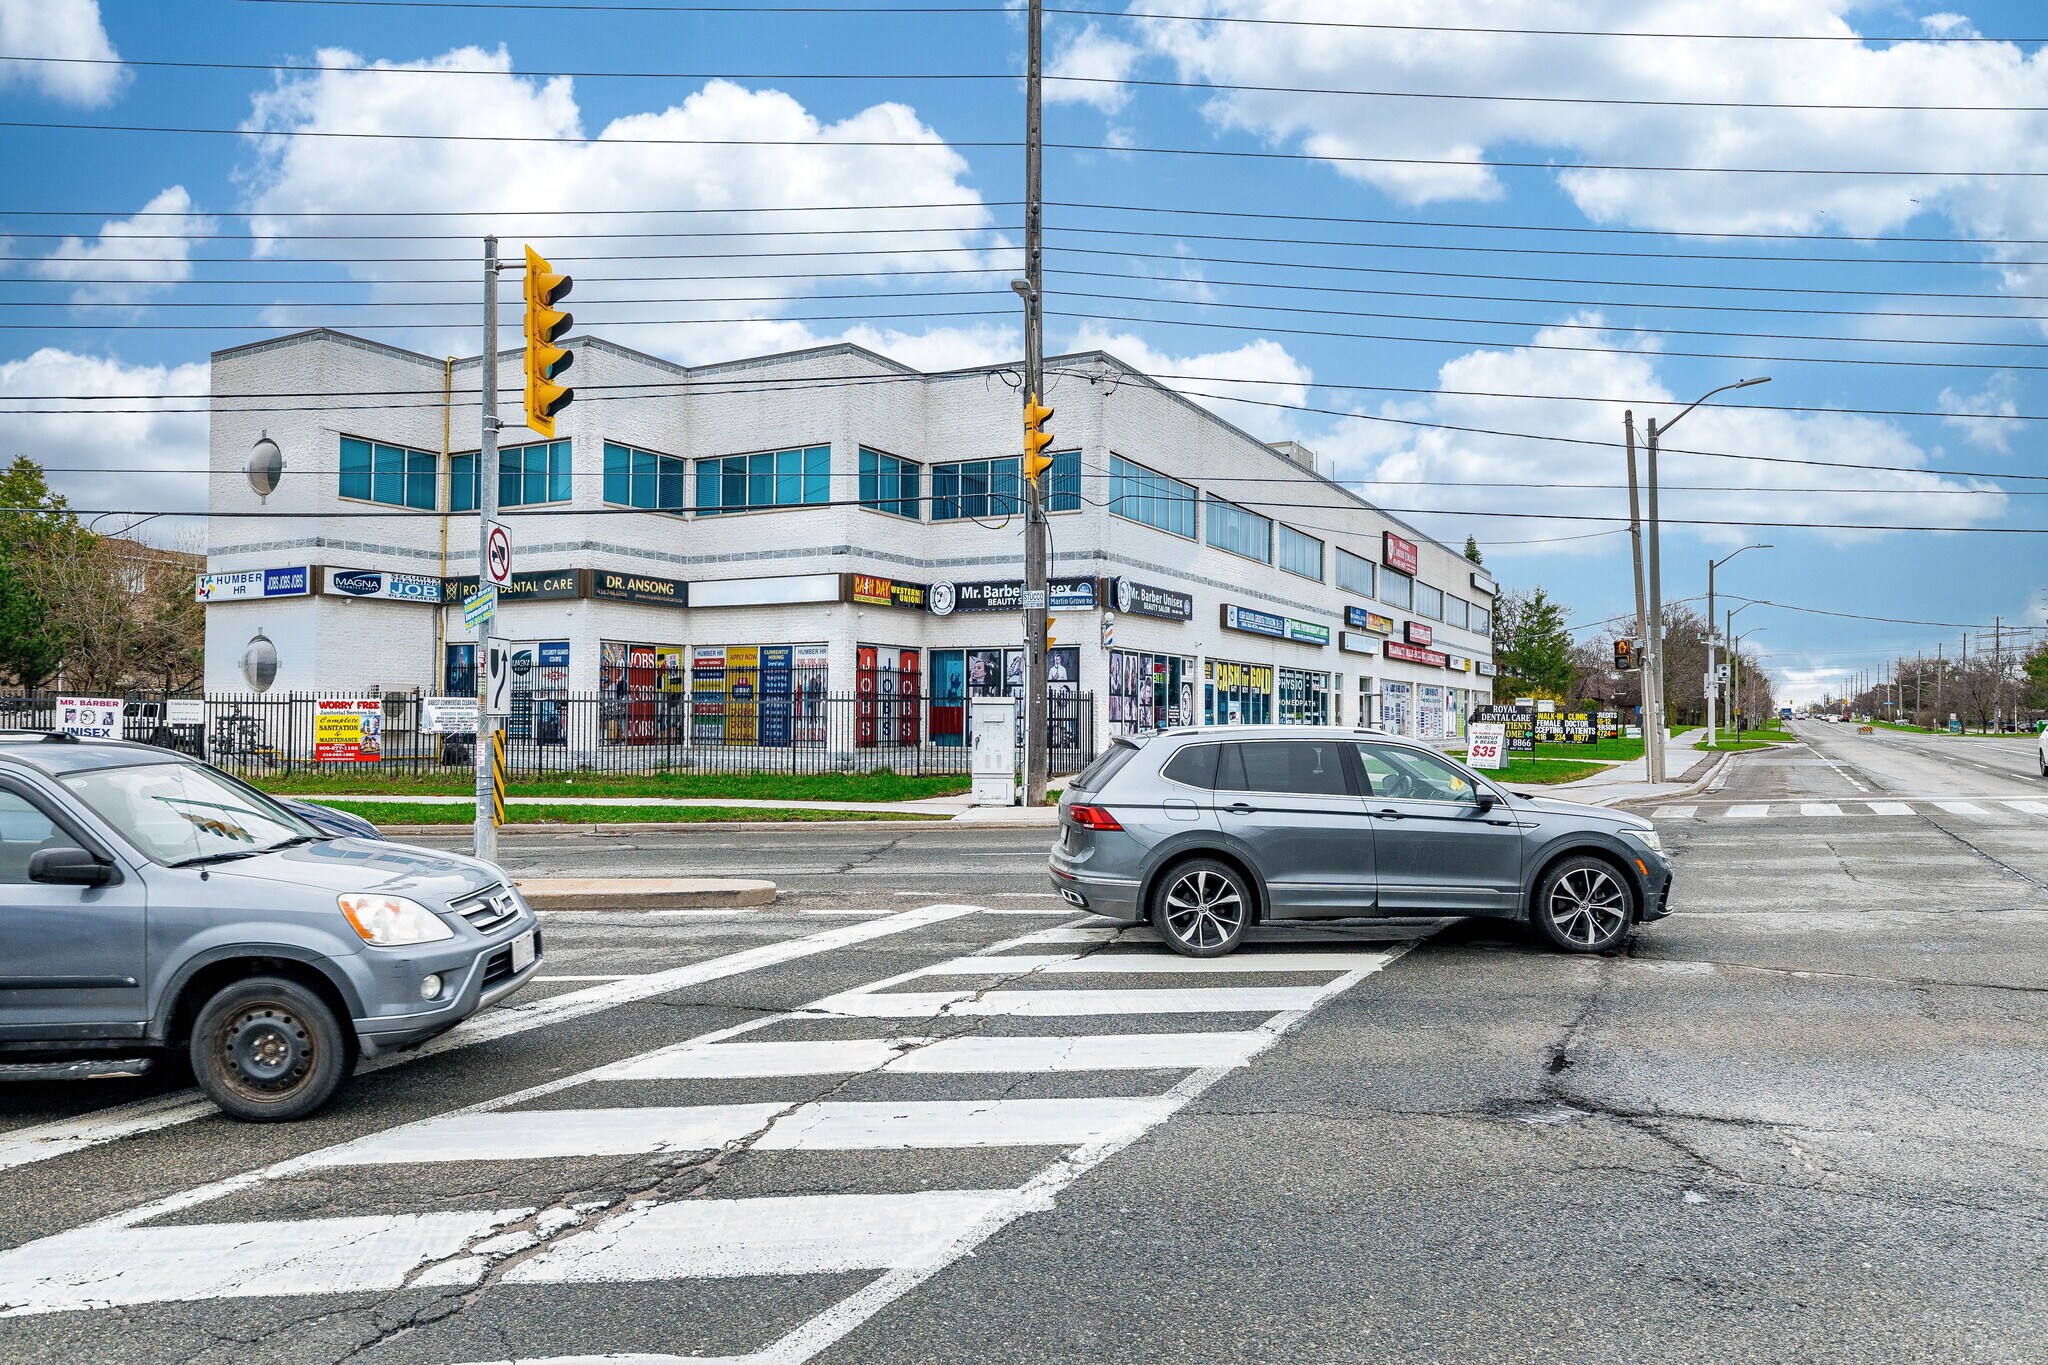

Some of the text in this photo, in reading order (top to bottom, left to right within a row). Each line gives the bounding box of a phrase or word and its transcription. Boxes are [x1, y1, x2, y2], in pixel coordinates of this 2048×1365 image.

[216, 573, 262, 585] HUMBER
[266, 574, 303, 591] JOBS JOBS JOBS
[335, 577, 379, 589] MAGNA
[391, 574, 440, 583] SECURITY
[391, 578, 440, 587] TRAINING
[391, 582, 438, 597] JOB
[463, 584, 480, 596] RO
[543, 578, 573, 591] CARE
[606, 575, 674, 595] DR. ANSONG
[875, 579, 891, 598] DAY
[233, 585, 246, 595] HR
[891, 585, 920, 597] WESTERN
[961, 583, 1072, 599] Mr. Barbe sex
[388, 594, 440, 602] PLACEMENT
[899, 594, 920, 604] UNION
[1024, 592, 1043, 601] STUCCO
[1050, 597, 1069, 605] Martin
[1069, 597, 1086, 605] Grove
[1130, 586, 1183, 608] Mr. Barber Unisex
[987, 598, 1016, 606] BEAUTY
[465, 602, 492, 622] Inventory
[1143, 602, 1170, 613] BEAUTY SALON
[628, 652, 654, 669] JOBS
[1217, 663, 1240, 692] CASH
[1252, 667, 1271, 695] GOLD
[318, 700, 380, 709] WORRY FREE
[1279, 699, 1318, 707] OMEOPATH
[1492, 705, 1518, 713] ROYAL
[1481, 713, 1531, 722] DENTAL CARE
[1537, 712, 1588, 721] WALK-IN CLINIC
[1506, 722, 1533, 730] TIENTS
[1564, 720, 1588, 728] DOCTOR
[1505, 730, 1525, 738] OME!
[1535, 726, 1596, 735] CCEPTING PATIENTS
[1535, 733, 1547, 741] 416
[1553, 733, 1566, 741] 234
[1573, 734, 1590, 742] 8977
[1512, 739, 1532, 747] 8866
[1471, 745, 1497, 758] $35
